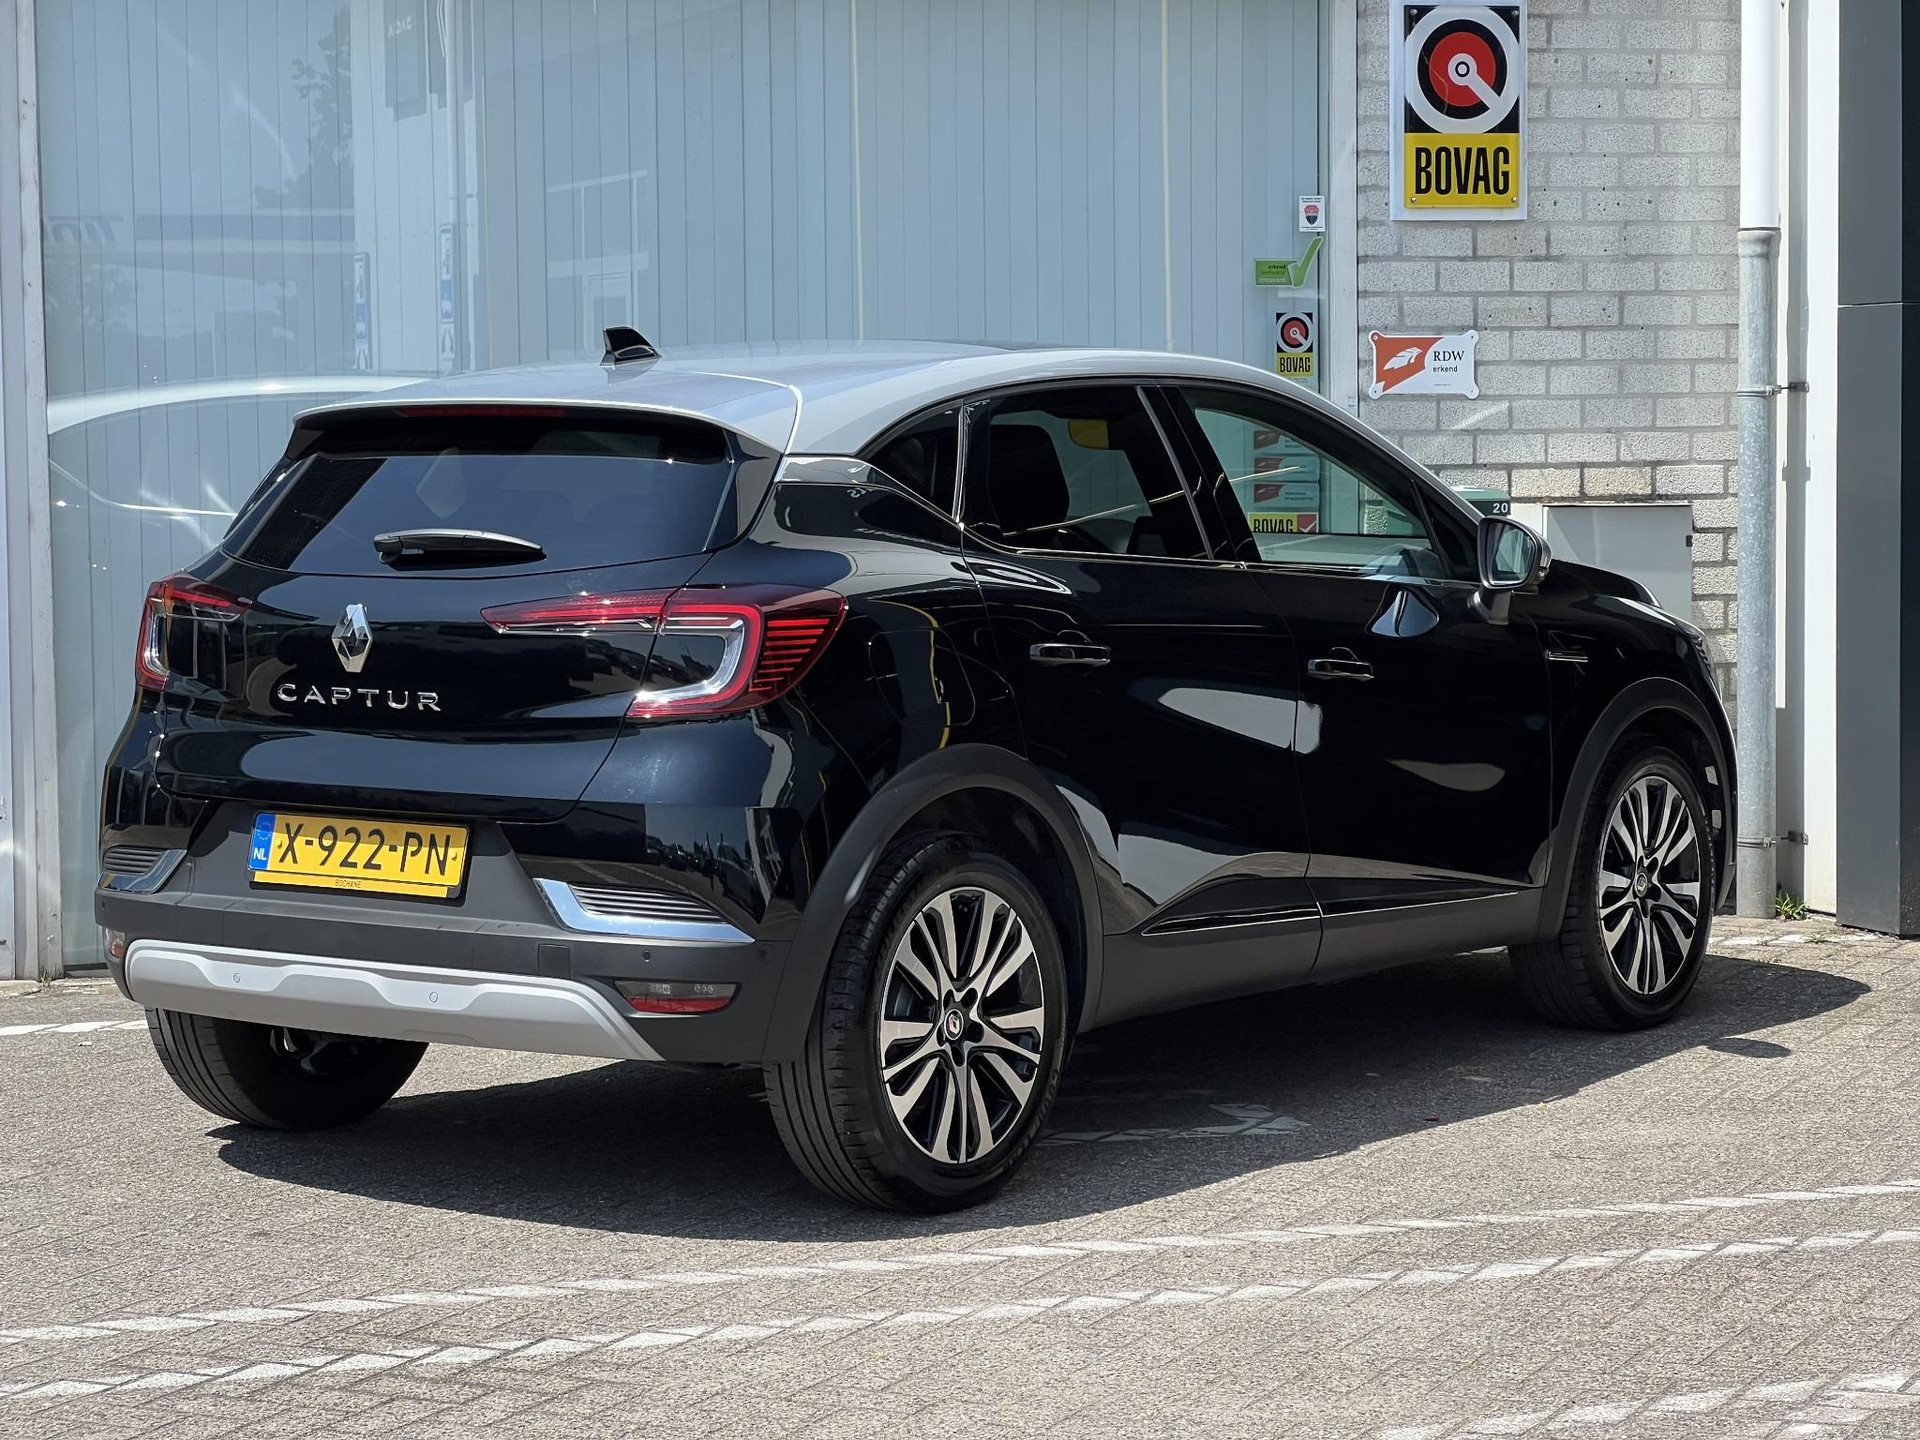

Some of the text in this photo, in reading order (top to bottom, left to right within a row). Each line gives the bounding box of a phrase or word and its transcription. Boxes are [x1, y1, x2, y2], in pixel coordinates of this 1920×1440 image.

[1414, 146, 1510, 196] BOVAG
[1432, 350, 1465, 362] RDW
[1279, 356, 1311, 373] BOVAG
[1432, 364, 1459, 373] erkend
[1492, 502, 1509, 514] 20
[1253, 518, 1293, 533] BOVAG
[278, 683, 441, 712] CAPTUR
[253, 848, 267, 860] NL
[279, 822, 451, 876] X-922-PN
